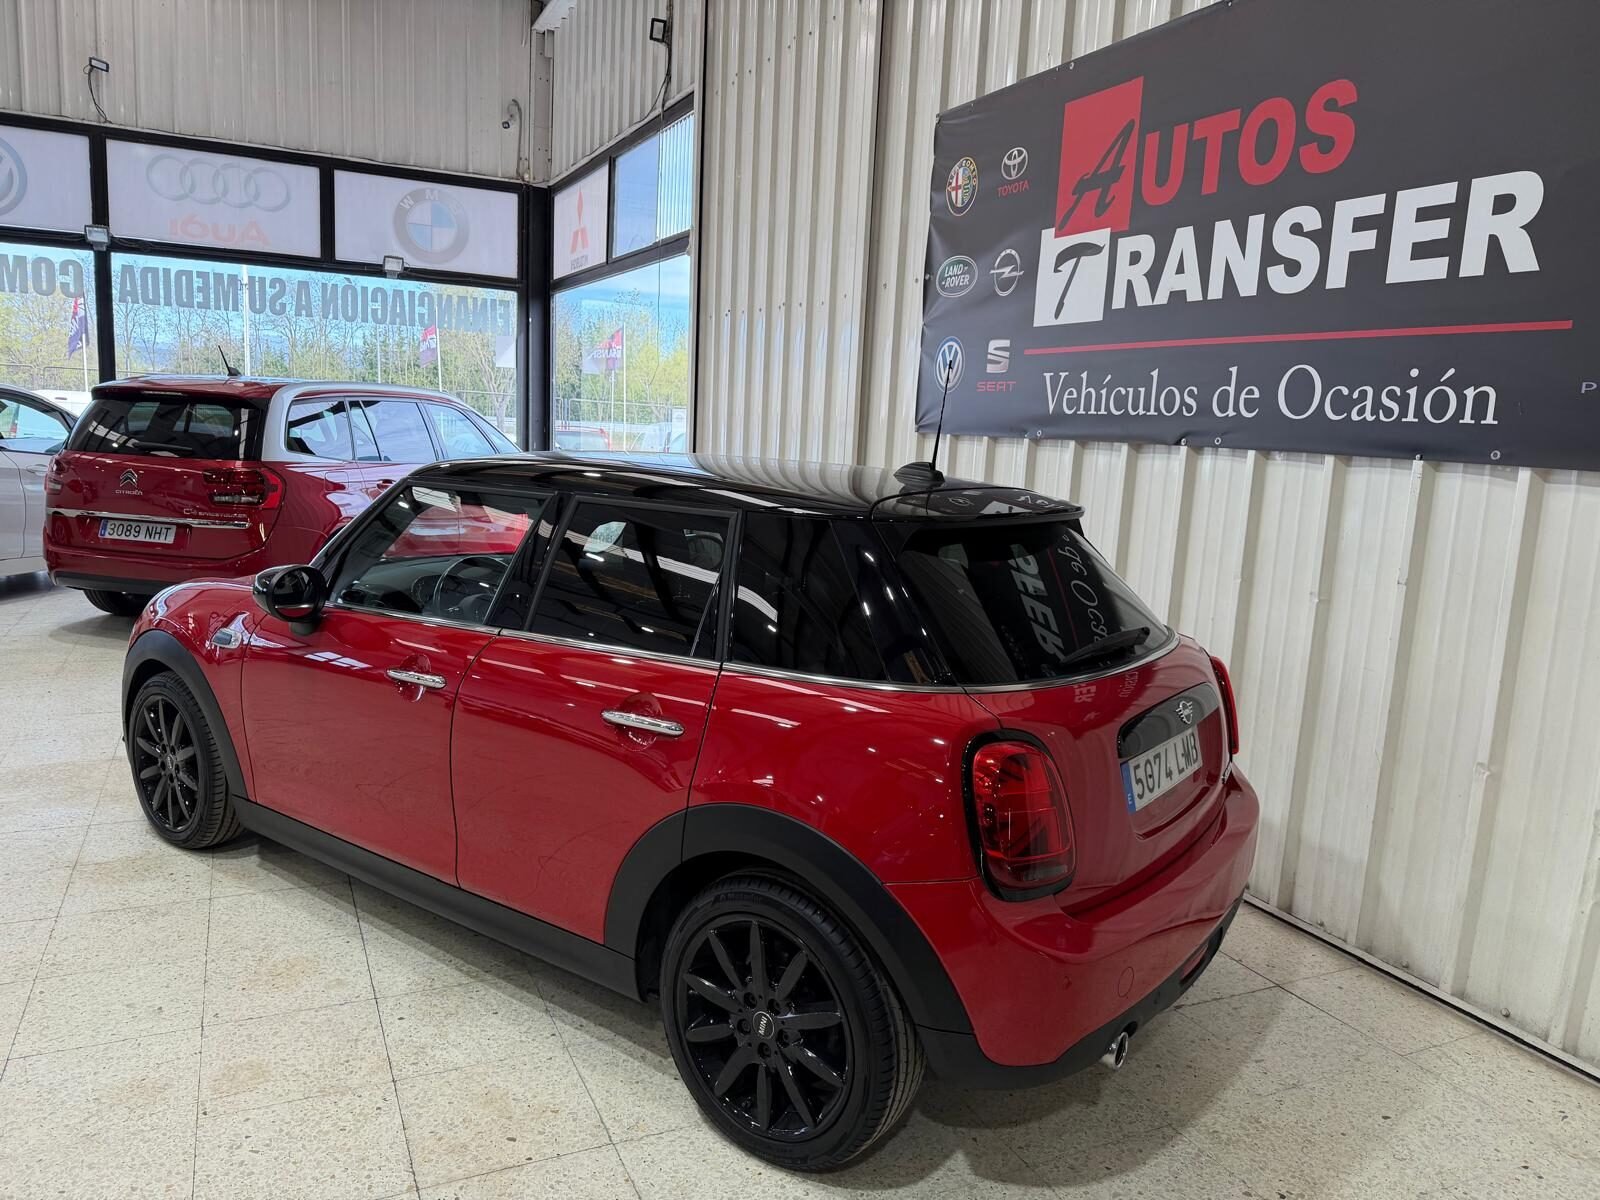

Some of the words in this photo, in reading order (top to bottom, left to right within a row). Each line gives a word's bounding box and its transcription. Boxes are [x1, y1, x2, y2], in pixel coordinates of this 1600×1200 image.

[1059, 78, 1358, 232] AUTOS
[997, 180, 1030, 197] TOYOTA
[1053, 170, 1544, 321] TRANSFER
[944, 264, 964, 278] LAND
[976, 381, 1017, 392] SEAT
[1043, 367, 1198, 416] Vehículos
[1212, 365, 1260, 418] de
[1277, 364, 1498, 425] Ocasión
[108, 522, 142, 538] 3089
[144, 525, 172, 541] NHT
[1133, 748, 1174, 800] 5074
[1173, 732, 1199, 775] LMB
